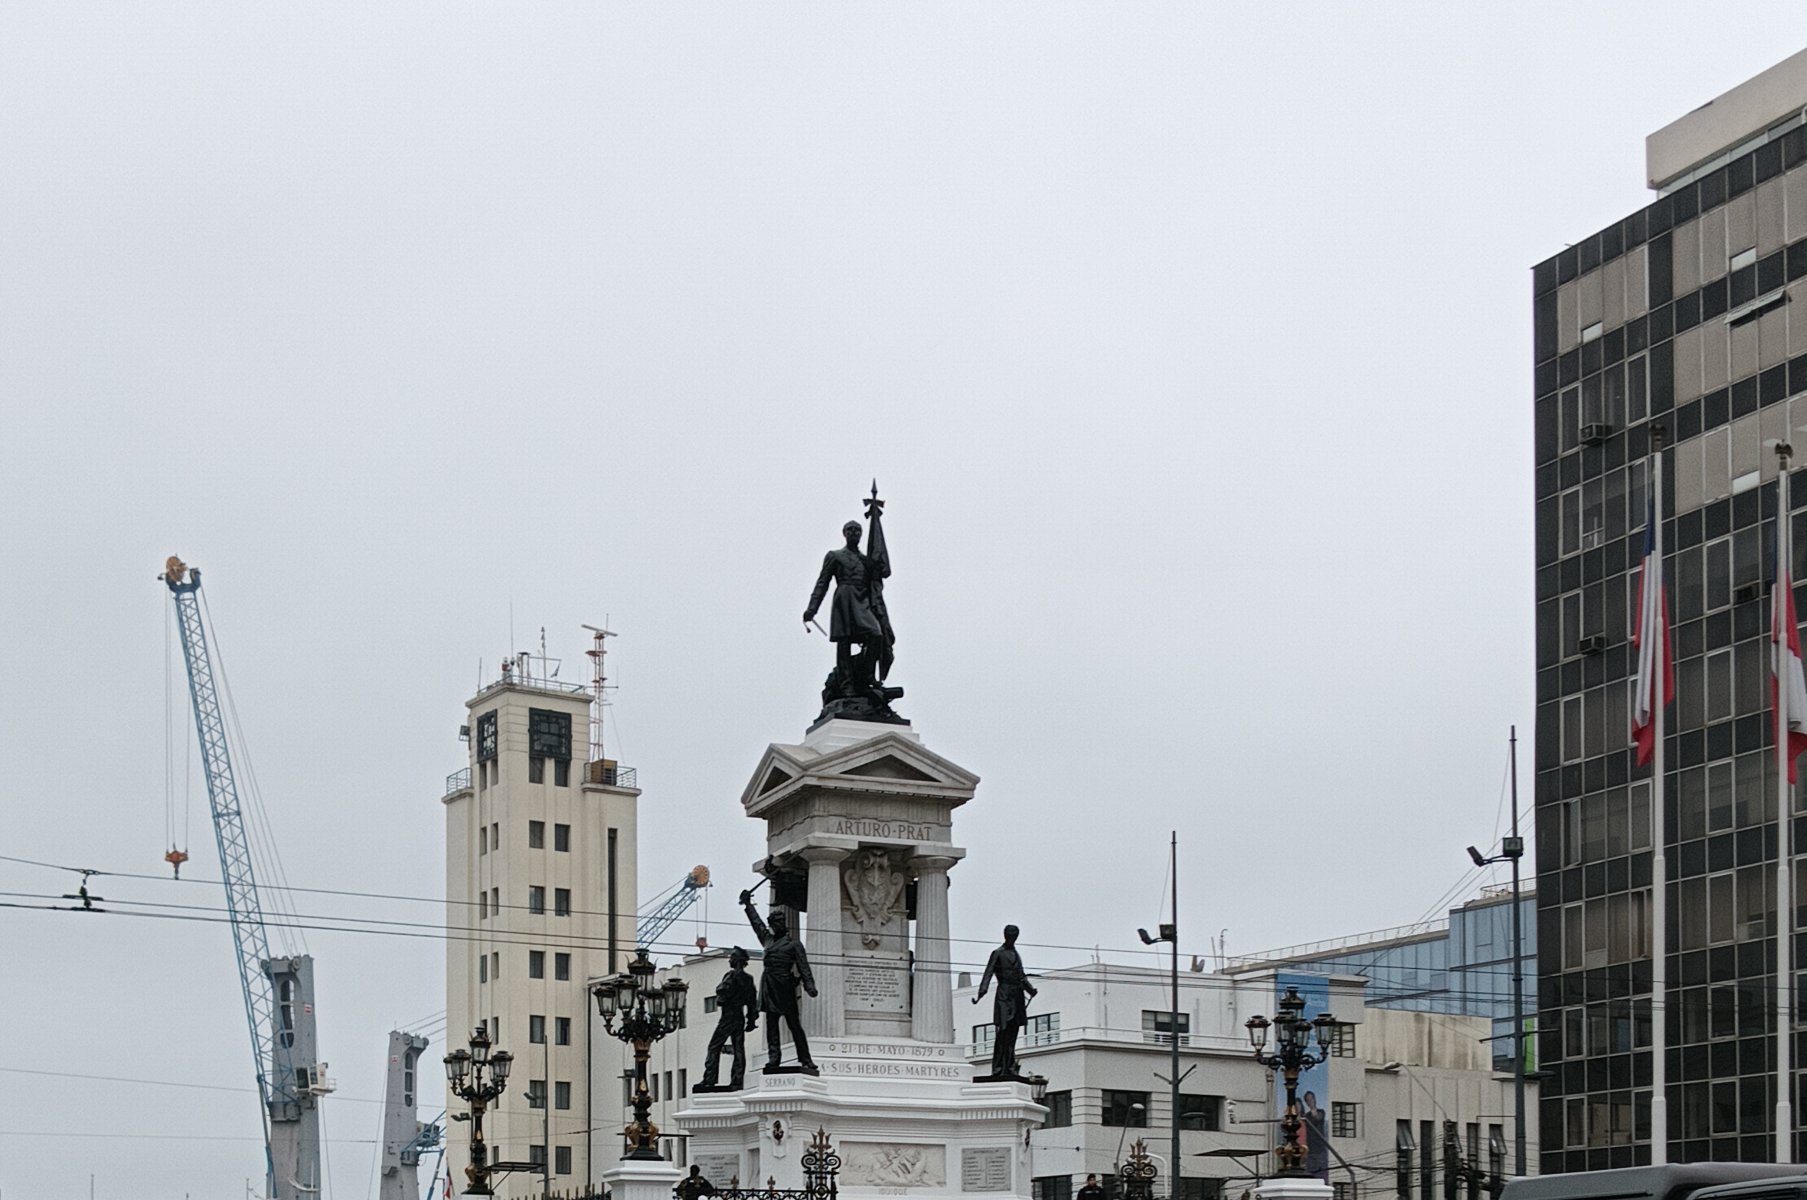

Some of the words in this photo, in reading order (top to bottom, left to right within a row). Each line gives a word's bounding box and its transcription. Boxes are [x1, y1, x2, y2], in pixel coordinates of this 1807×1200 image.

[835, 820, 891, 838] ARTURO
[898, 824, 932, 841] PRAT
[878, 1045, 905, 1055] MAYO
[831, 1063, 852, 1073] SUS
[857, 1064, 900, 1075] HEROES
[906, 1065, 959, 1078] MARTYRES
